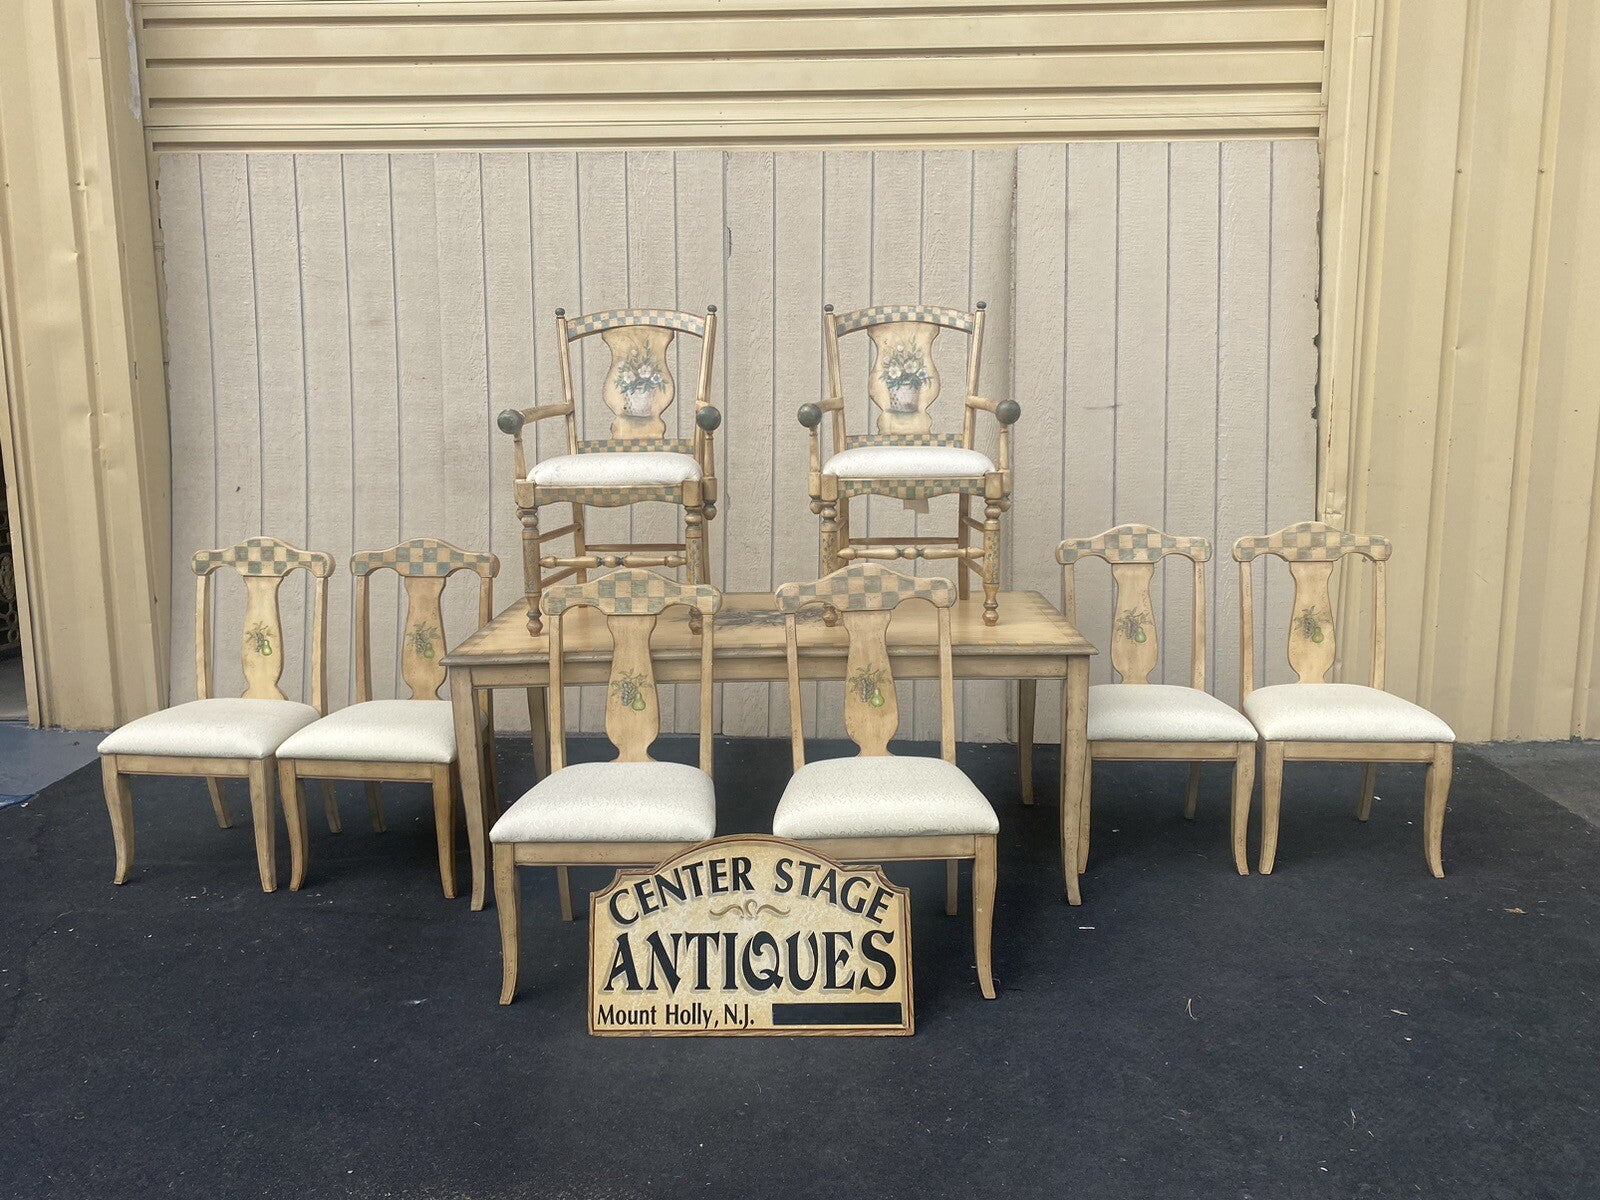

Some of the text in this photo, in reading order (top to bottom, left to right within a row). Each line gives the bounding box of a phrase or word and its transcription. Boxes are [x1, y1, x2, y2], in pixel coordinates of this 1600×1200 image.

[609, 856, 894, 925] CENTER STAGE
[603, 929, 897, 995] ANTIQUES
[597, 1003, 755, 1029] Mount Holly, N.J.
